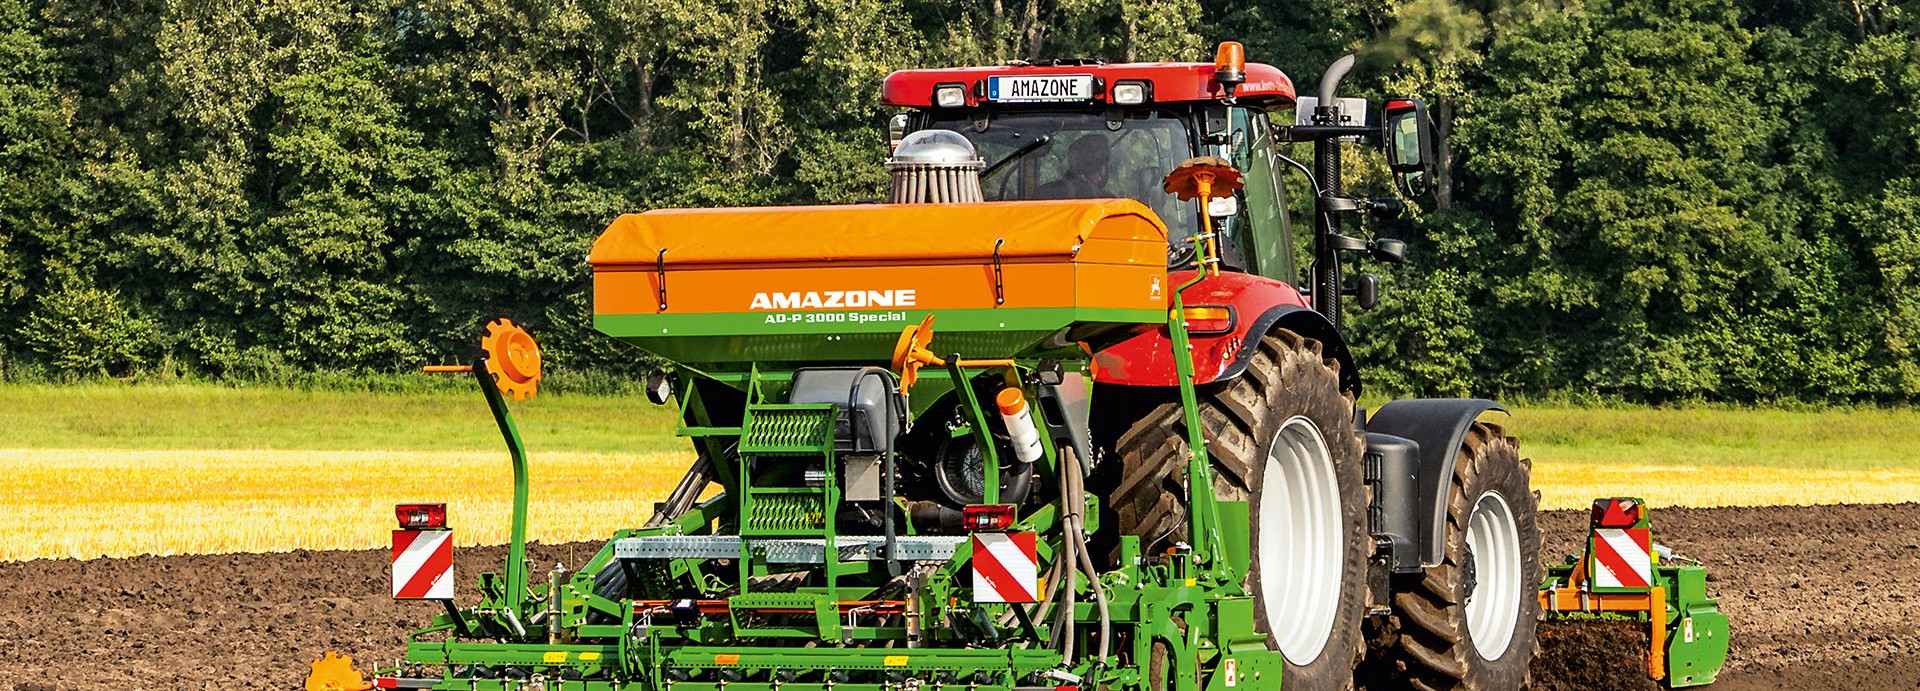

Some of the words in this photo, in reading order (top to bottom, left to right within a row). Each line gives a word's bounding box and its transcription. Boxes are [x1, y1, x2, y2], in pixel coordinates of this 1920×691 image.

[1011, 79, 1078, 97] AMAZONE
[749, 289, 916, 310] AMAZONE
[764, 313, 802, 324] AD-P
[805, 313, 845, 323] 3000
[848, 311, 906, 324] Special
